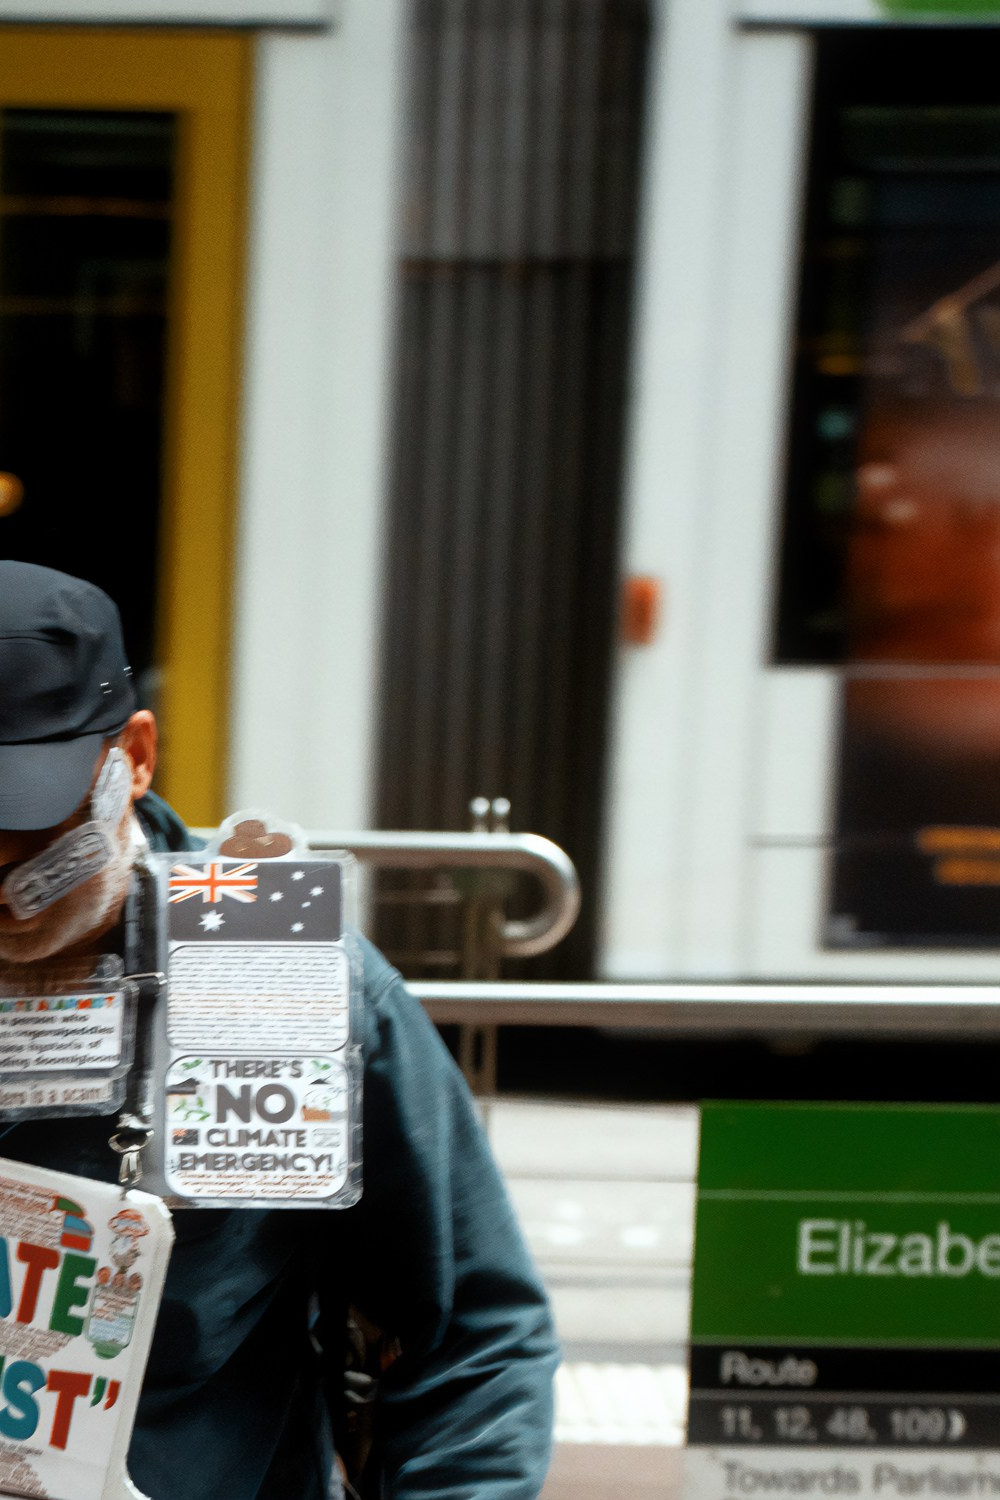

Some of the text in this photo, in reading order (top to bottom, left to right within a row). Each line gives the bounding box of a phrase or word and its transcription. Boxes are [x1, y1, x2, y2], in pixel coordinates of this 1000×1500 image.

[209, 1060, 304, 1079] THERE'S
[216, 1083, 296, 1124] NO
[206, 1128, 308, 1148] CLIMATE
[178, 1152, 333, 1172] EMERGENCY!
[720, 1351, 818, 1386] Route
